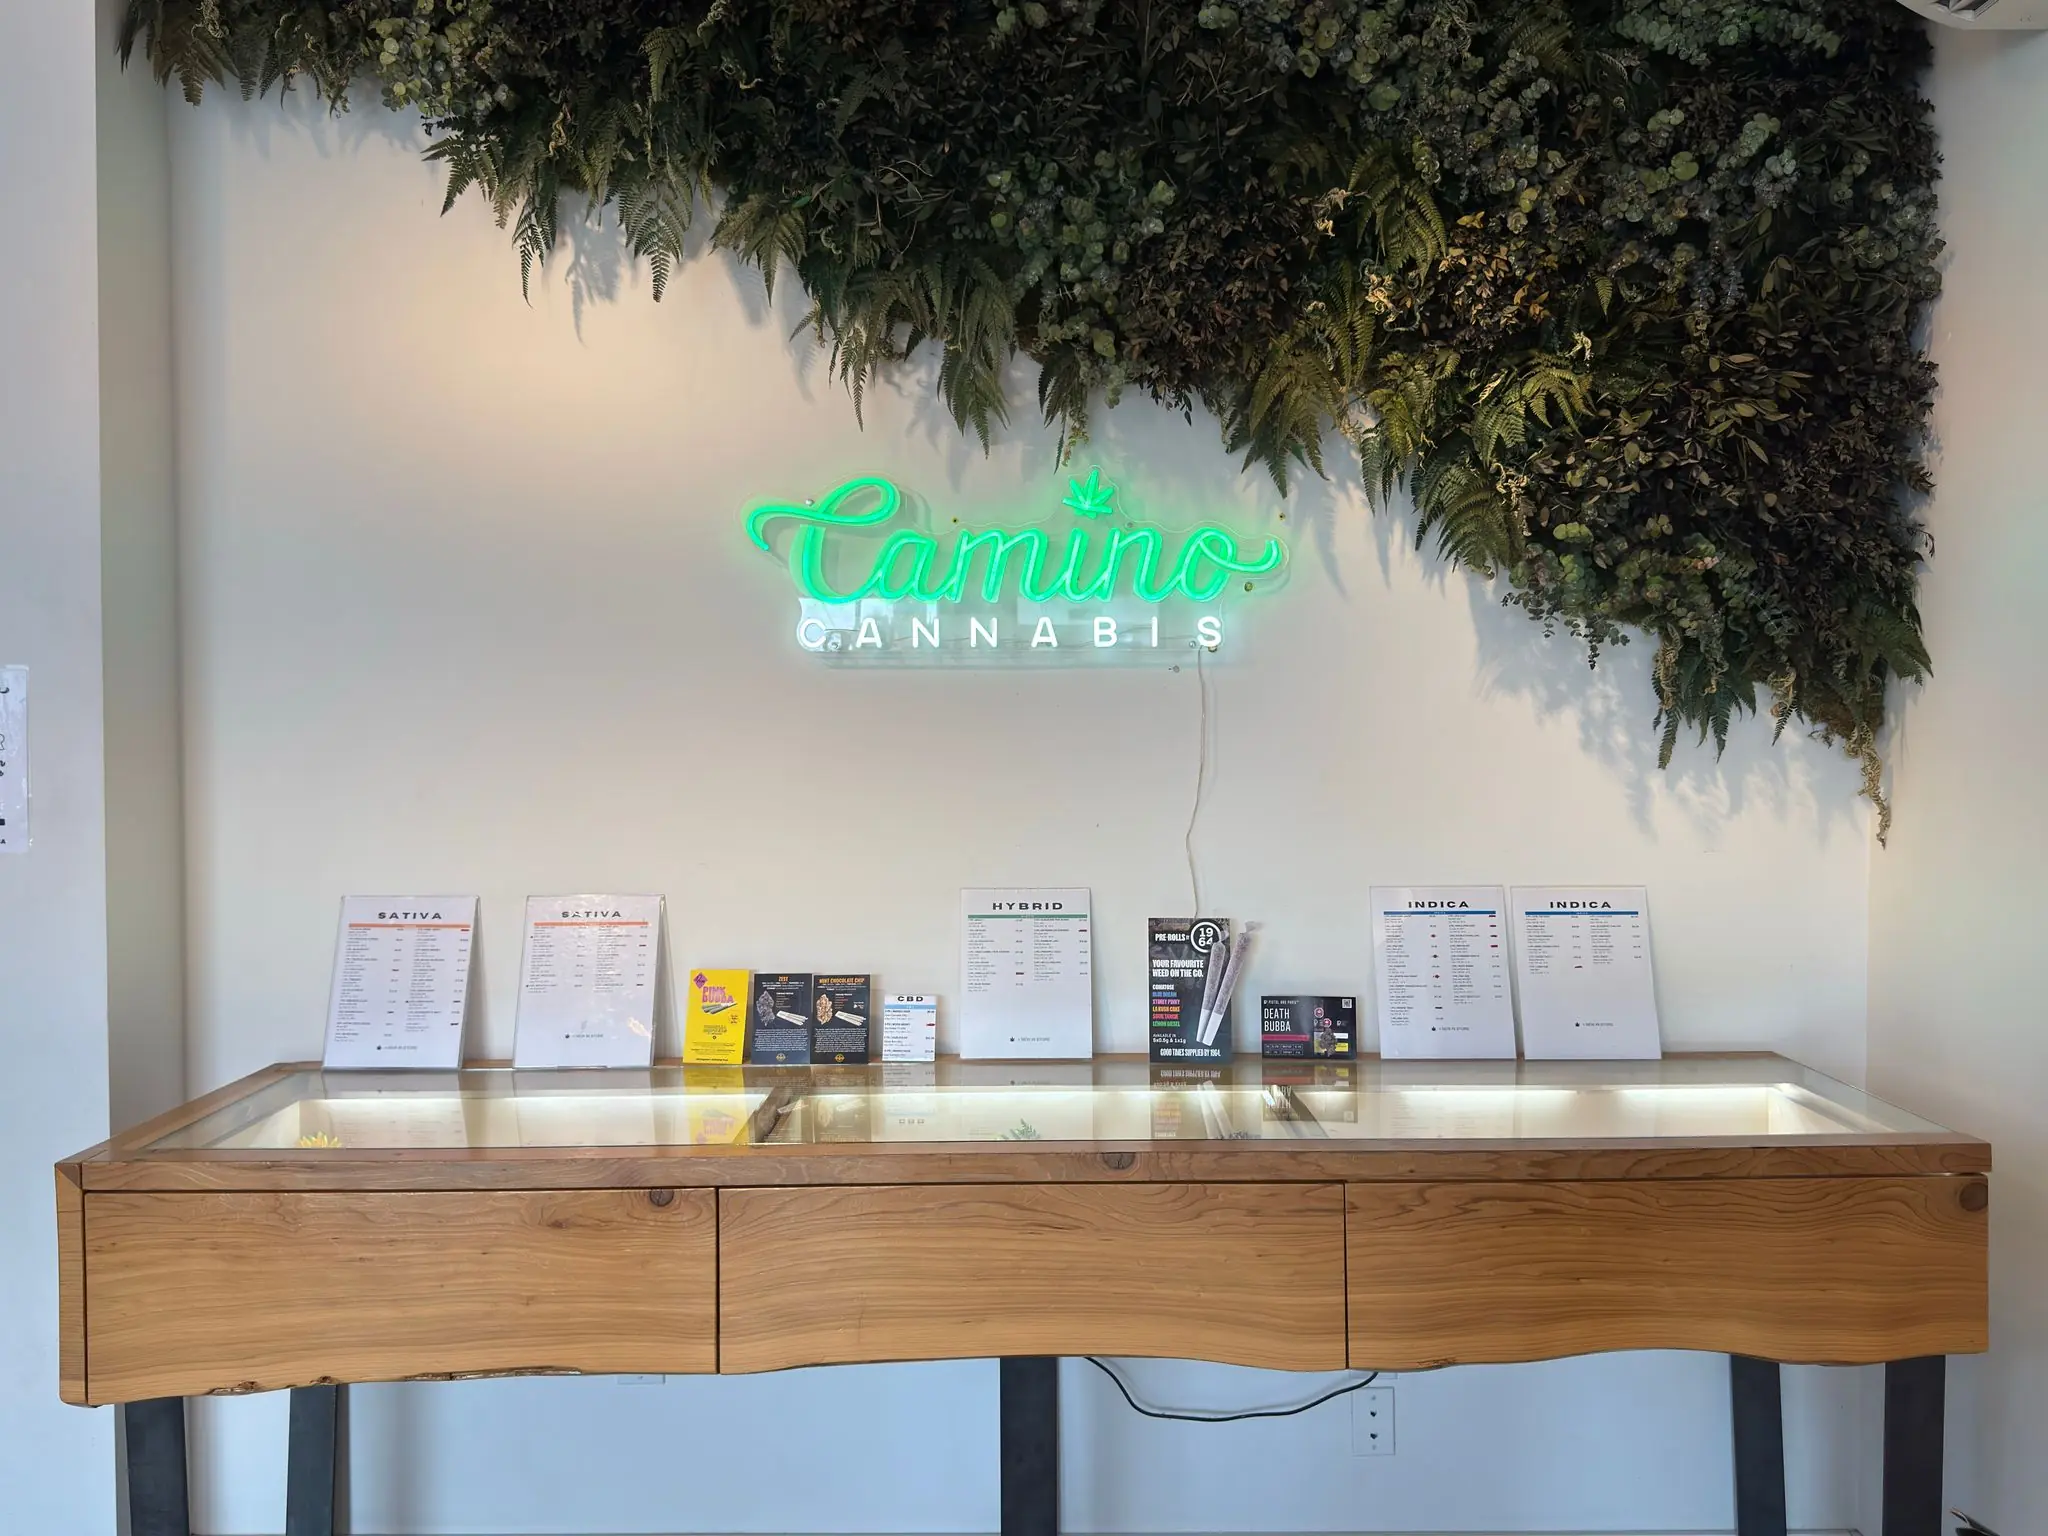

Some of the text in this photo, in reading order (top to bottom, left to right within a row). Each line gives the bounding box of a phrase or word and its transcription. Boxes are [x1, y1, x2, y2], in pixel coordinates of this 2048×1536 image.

[746, 471, 1282, 603] Camino
[798, 616, 1224, 648] CANNABIS
[992, 902, 1063, 910] HYBRID
[1550, 901, 1612, 909] INDICA
[1199, 928, 1214, 937] 19
[1153, 959, 1204, 968] YOUR FAVOURITE
[1153, 969, 1169, 978] WEED
[1170, 969, 1180, 978] ON
[1180, 969, 1192, 978] THE
[1264, 1008, 1290, 1019] DEATH
[1264, 1021, 1291, 1032] BUBBA
